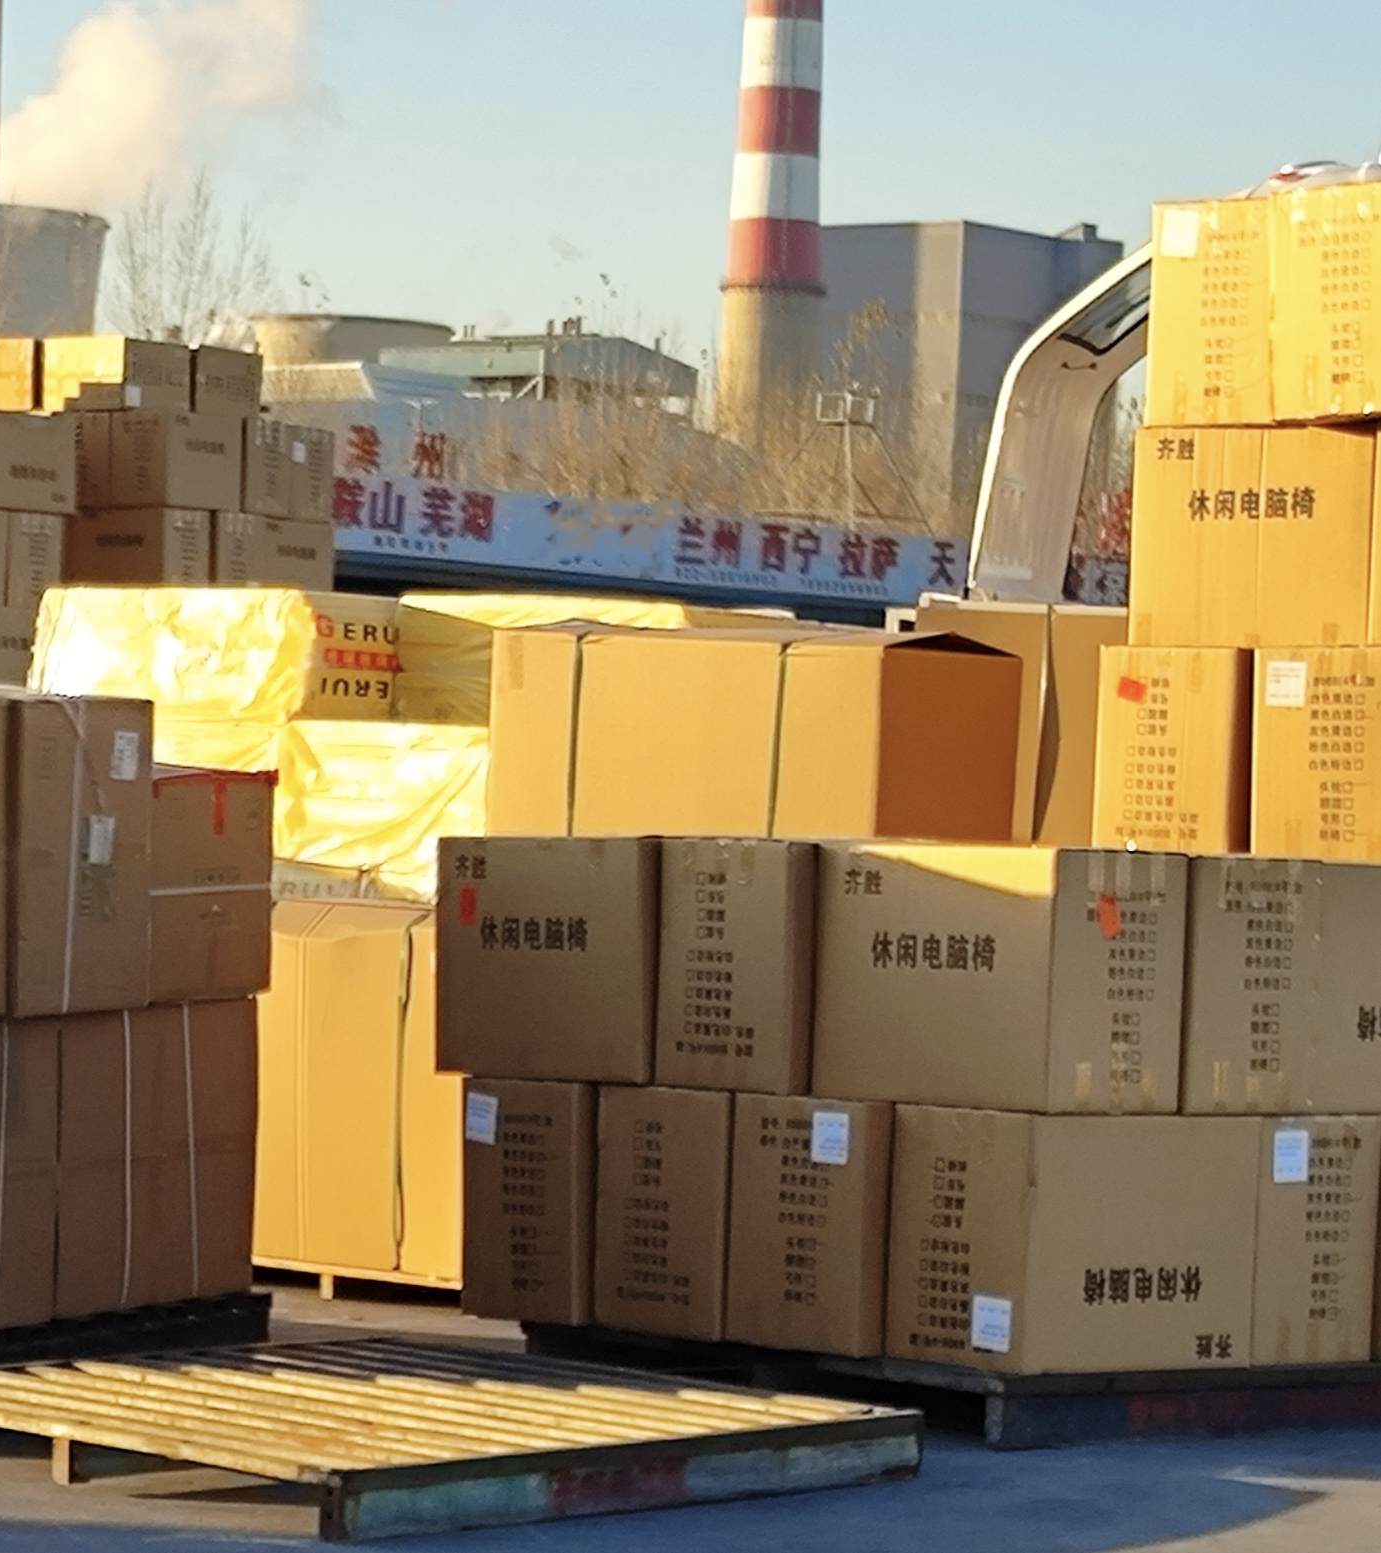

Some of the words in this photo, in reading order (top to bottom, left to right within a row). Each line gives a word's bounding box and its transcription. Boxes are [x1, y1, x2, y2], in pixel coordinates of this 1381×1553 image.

[1157, 438, 1196, 460] 齐胜
[1188, 486, 1316, 521] 休闲电脑椅
[675, 517, 742, 568] 兰州
[760, 524, 819, 574] 西宁
[839, 534, 900, 580] 拉萨
[928, 541, 955, 586] 天
[845, 869, 882, 894] 齐胜
[481, 916, 587, 951] 休闲电脑椅
[872, 931, 995, 972] 休闲电脑椅
[1084, 1266, 1202, 1305] 休闲电脑椅
